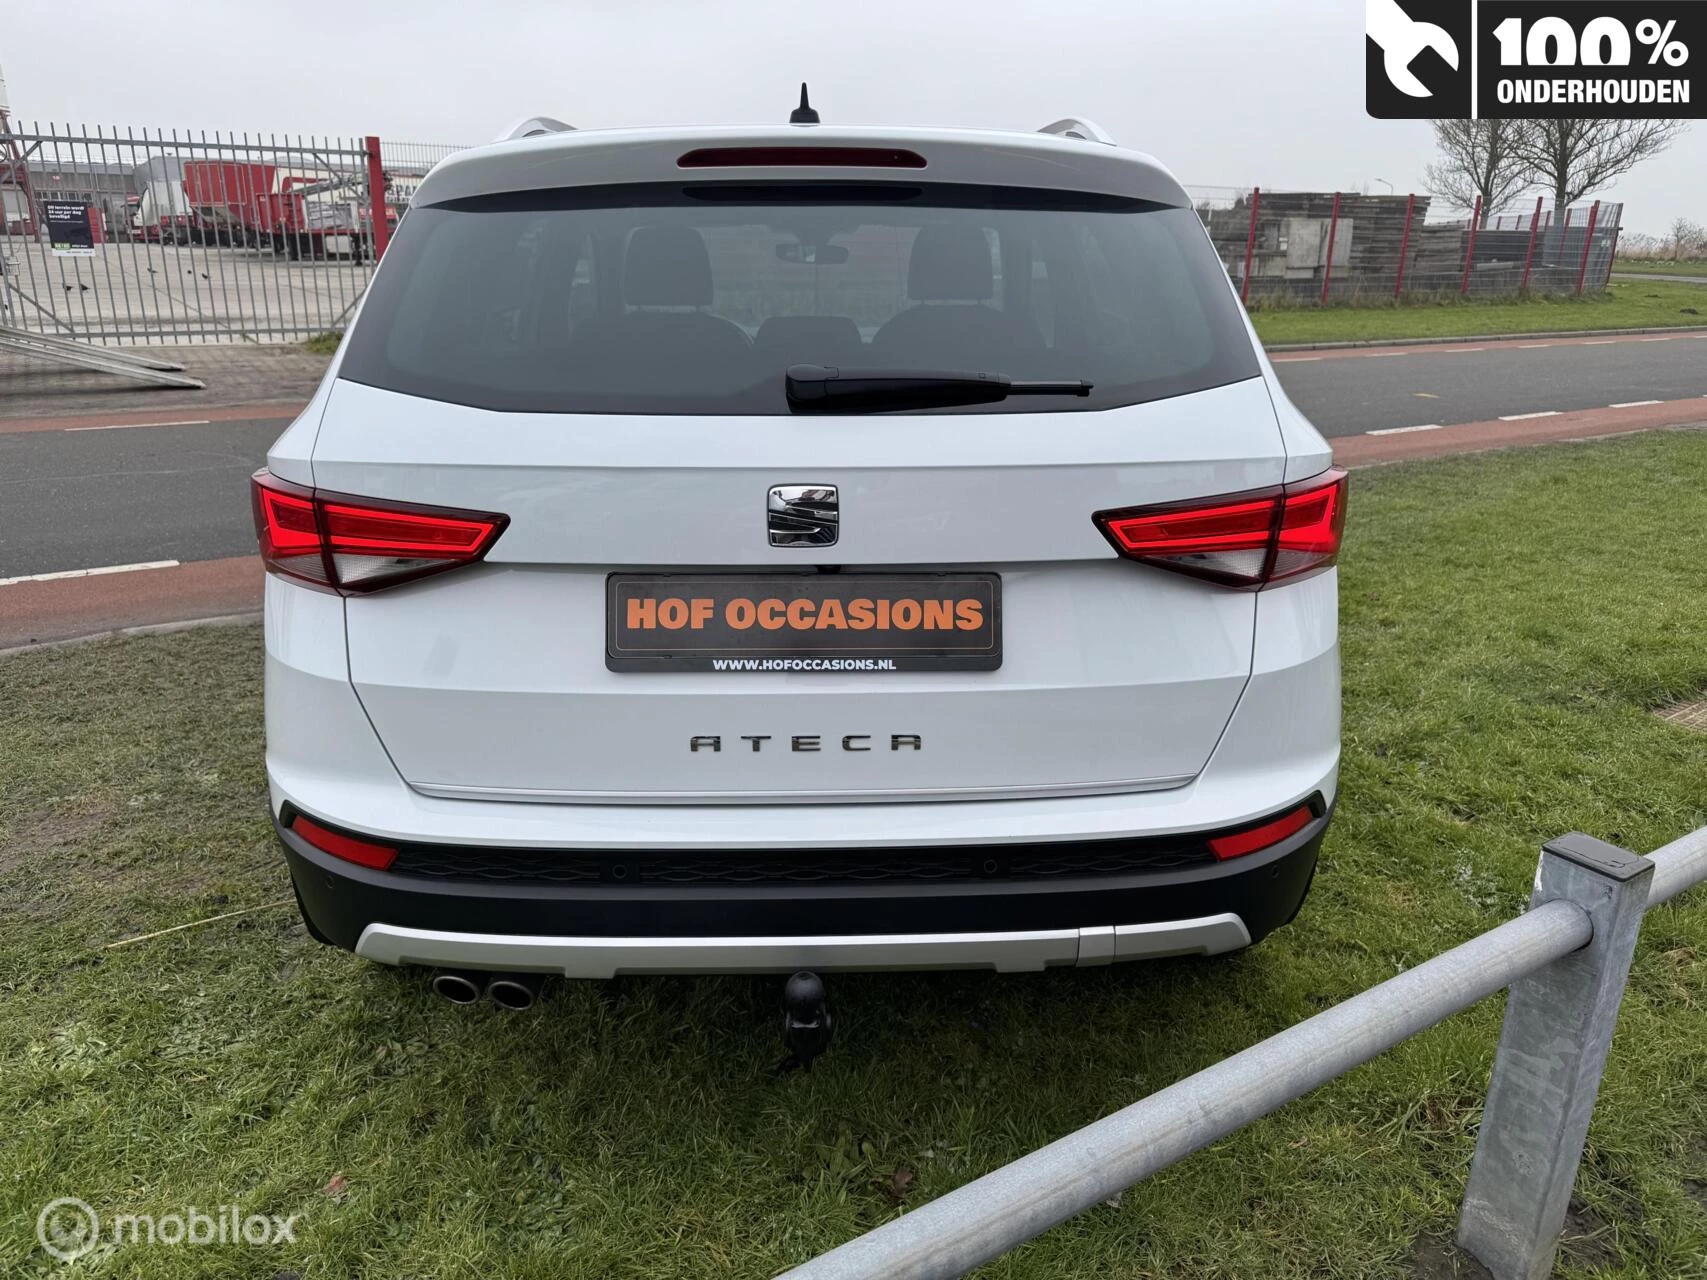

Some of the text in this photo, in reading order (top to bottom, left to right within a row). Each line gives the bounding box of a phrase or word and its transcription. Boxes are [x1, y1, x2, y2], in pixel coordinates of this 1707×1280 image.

[627, 598, 984, 631] HOF OCCASIONS
[712, 658, 897, 671] WWW.HOFOCCASIONS.NL
[690, 734, 922, 752] ATECA
